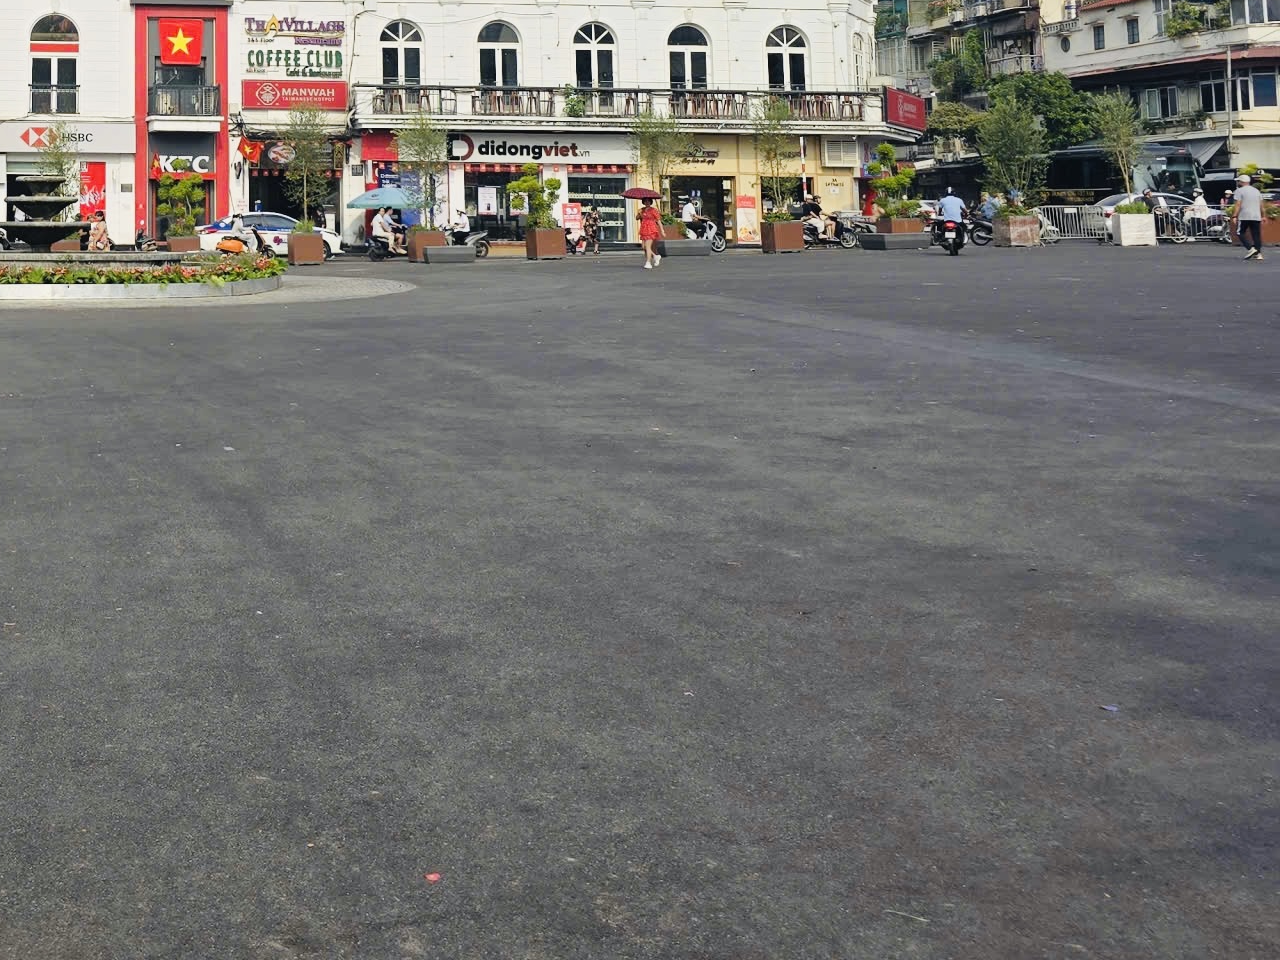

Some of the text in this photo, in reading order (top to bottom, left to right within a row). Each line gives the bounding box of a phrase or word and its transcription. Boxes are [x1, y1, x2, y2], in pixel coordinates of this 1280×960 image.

[247, 49, 343, 68] COFFEE CLUB
[281, 87, 335, 97] MANWAH
[61, 132, 93, 142] HSBC
